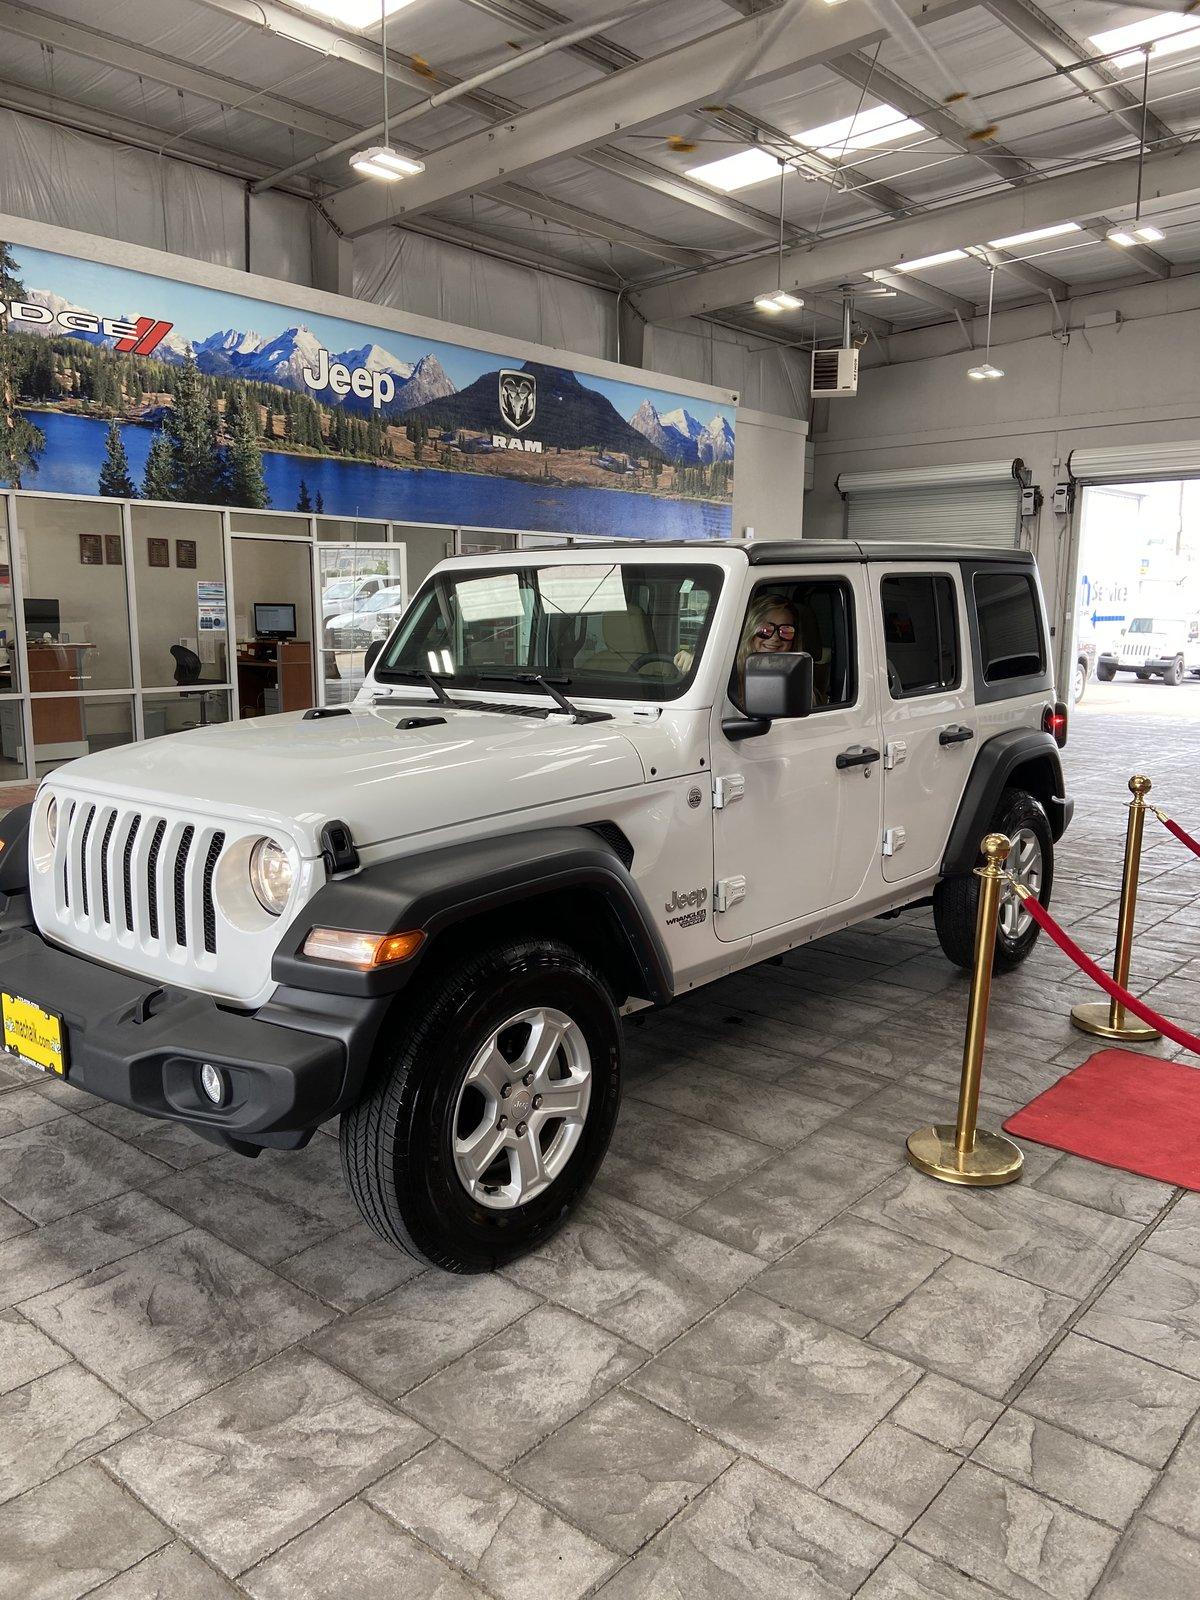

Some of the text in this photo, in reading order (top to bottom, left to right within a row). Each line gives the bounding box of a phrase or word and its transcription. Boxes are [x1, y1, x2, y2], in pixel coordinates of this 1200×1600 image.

[0, 301, 139, 341] DGE
[303, 348, 395, 409] Jeep
[492, 434, 542, 453] RAM
[1092, 580, 1127, 601] Sevice
[665, 887, 707, 913] Jeep
[666, 909, 706, 926] WRANGLER
